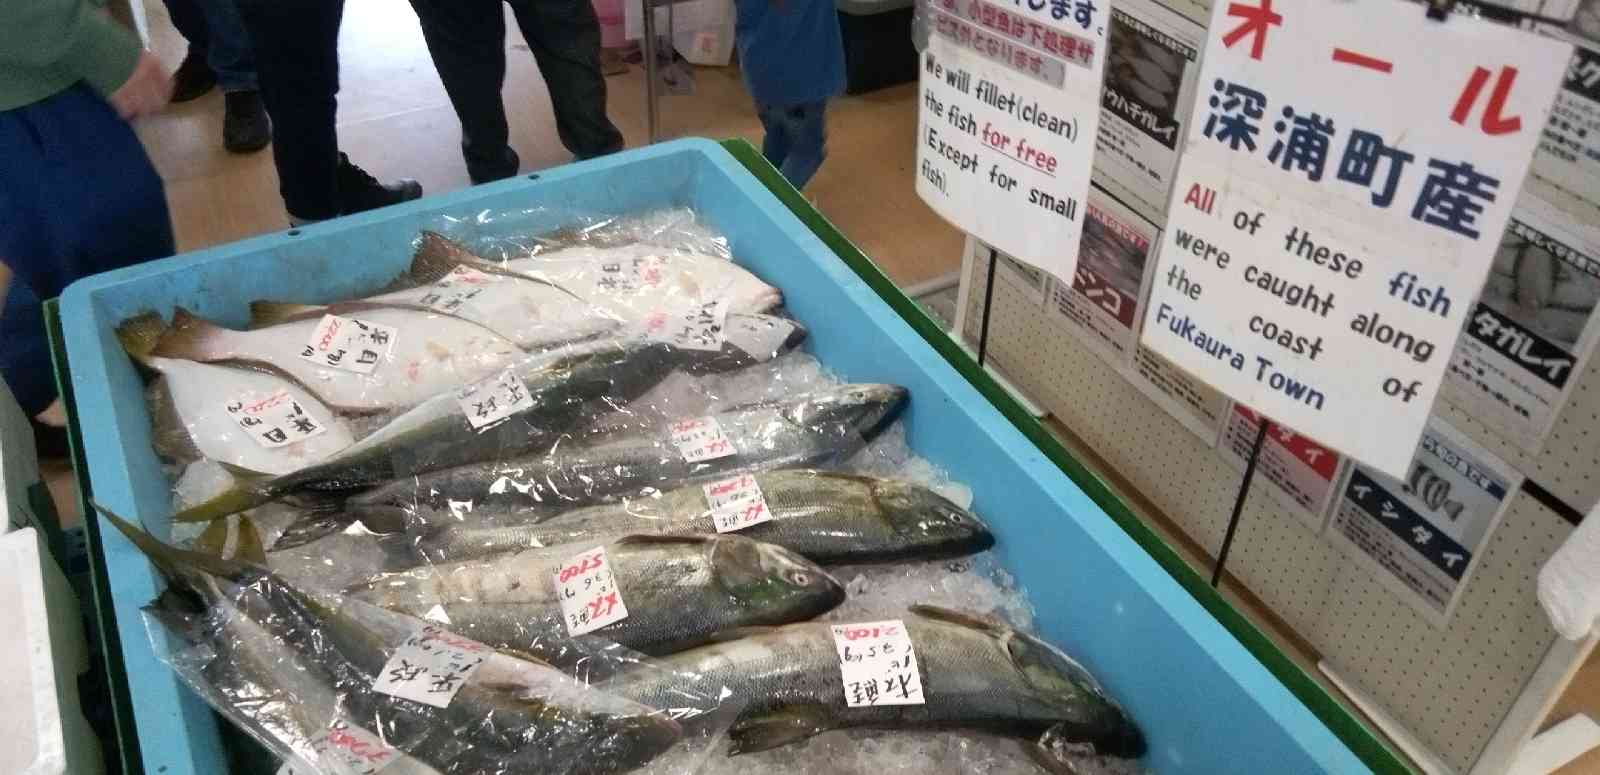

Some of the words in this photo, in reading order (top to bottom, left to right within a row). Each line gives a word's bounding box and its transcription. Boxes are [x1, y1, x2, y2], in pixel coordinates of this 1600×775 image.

[926, 52, 943, 79] We
[946, 68, 971, 94] will
[1222, 0, 1521, 136] オール
[921, 157, 949, 198] fish).
[923, 122, 978, 174] (Except
[989, 164, 1018, 192] for
[1027, 187, 1077, 221] small
[924, 88, 943, 117] the
[948, 104, 977, 136] fish
[982, 122, 1010, 150] for
[1017, 138, 1058, 173] free
[1203, 78, 1500, 240] 深浦町産
[1174, 229, 1231, 269] were
[1243, 263, 1335, 319] caught
[1350, 313, 1434, 364] along
[1184, 182, 1216, 215] All
[1233, 211, 1264, 236] of
[1285, 226, 1363, 279] these
[1388, 272, 1453, 319] fish
[1156, 304, 1245, 371] Fukaura
[1254, 356, 1325, 411] Town
[1167, 264, 1202, 300] the
[1248, 315, 1323, 360] coast
[1382, 376, 1423, 403] of
